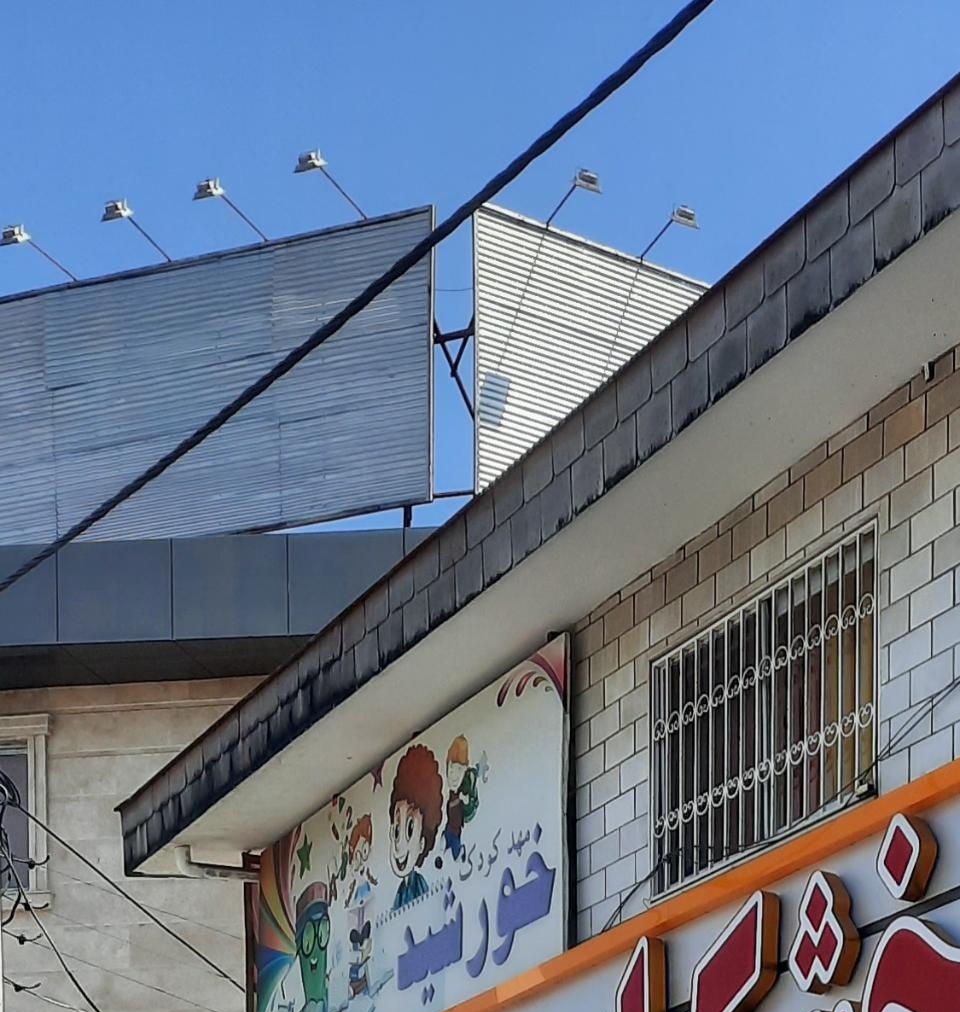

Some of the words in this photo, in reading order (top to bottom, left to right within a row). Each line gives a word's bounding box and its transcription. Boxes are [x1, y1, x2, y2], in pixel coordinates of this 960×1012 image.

[459, 827, 501, 881] کودک
[508, 829, 531, 857] مهد
[397, 822, 556, 1006] خورشید
